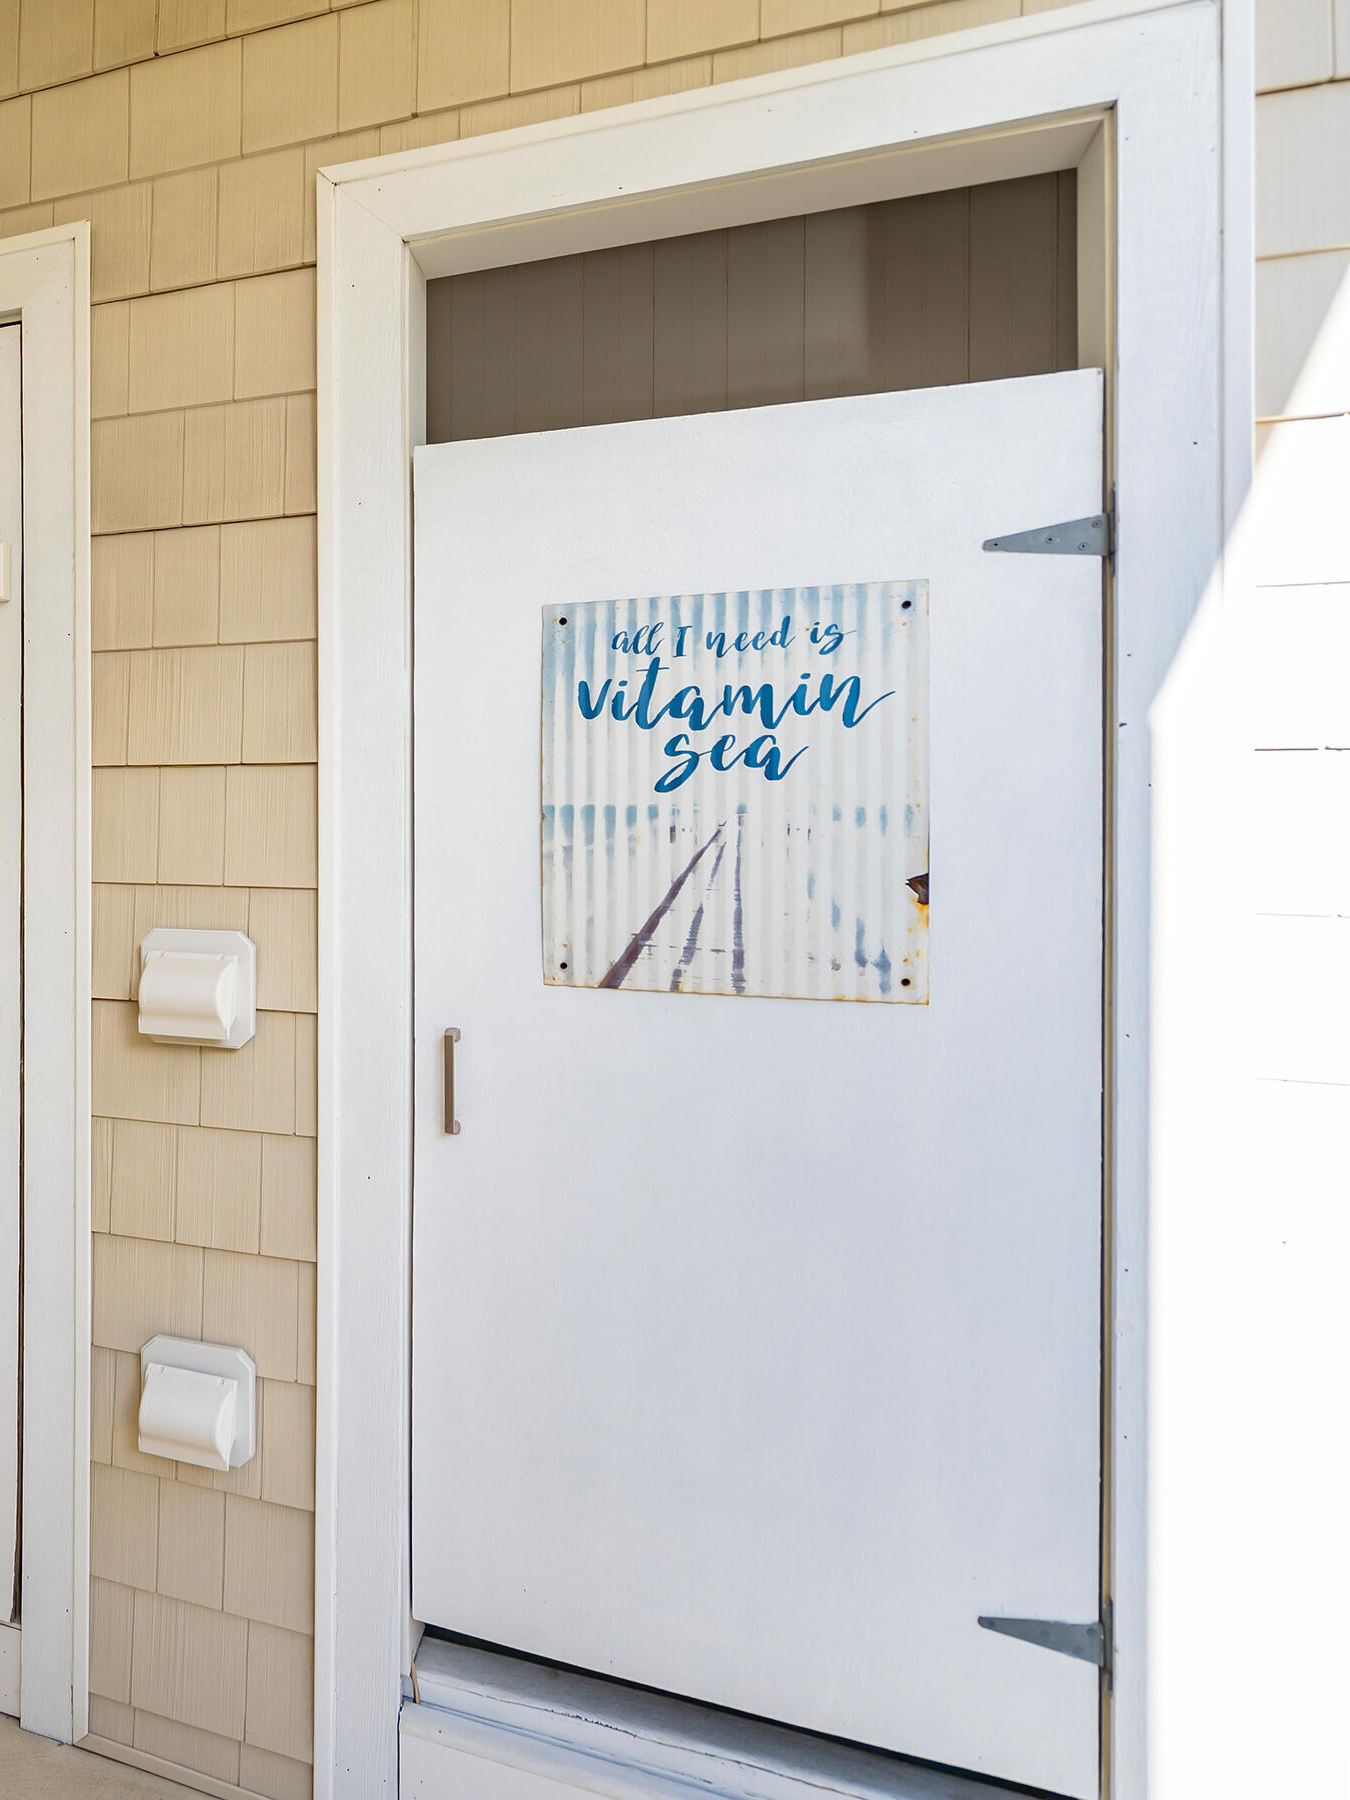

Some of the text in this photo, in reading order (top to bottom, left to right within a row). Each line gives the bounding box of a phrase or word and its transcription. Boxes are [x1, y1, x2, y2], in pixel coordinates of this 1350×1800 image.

[611, 615, 856, 658] all I need is
[578, 656, 896, 731] vitamin
[654, 734, 809, 793] sea
